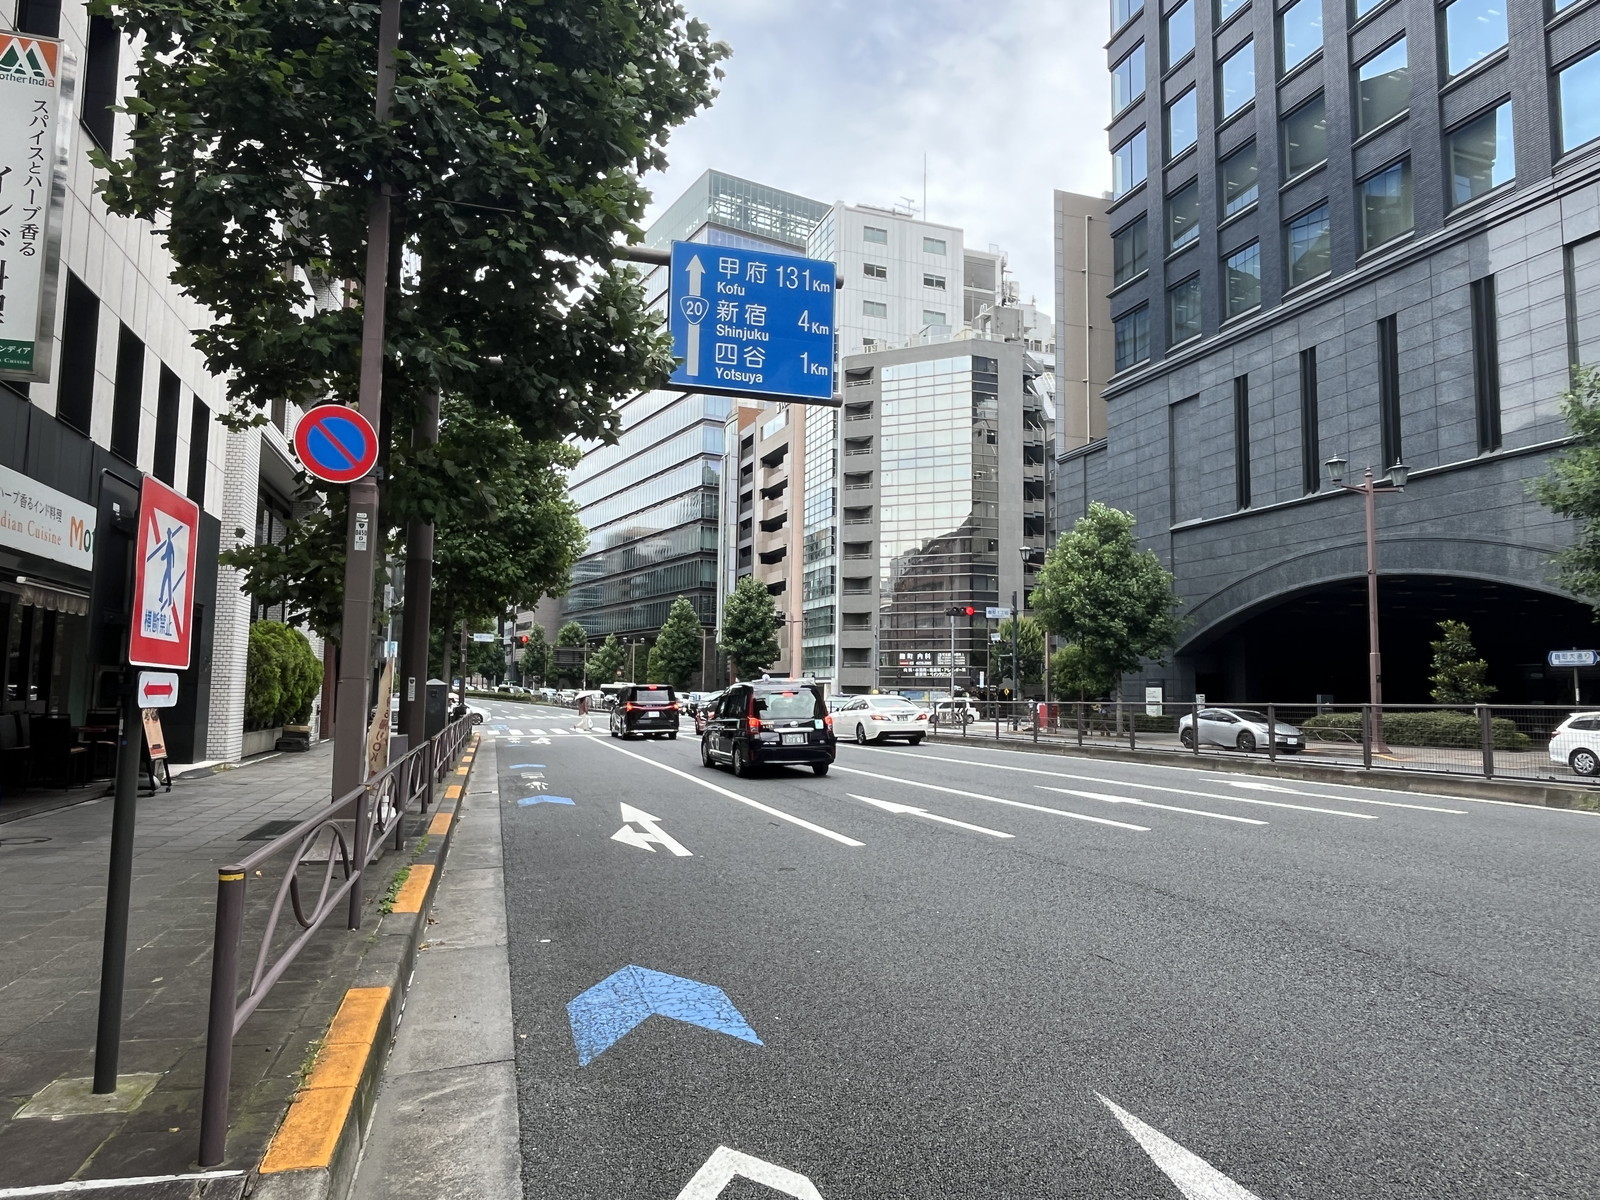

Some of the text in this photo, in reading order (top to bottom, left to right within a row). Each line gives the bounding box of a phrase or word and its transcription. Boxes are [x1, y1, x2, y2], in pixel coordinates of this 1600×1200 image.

[28, 76, 55, 88] India
[19, 99, 49, 257] スパイスとハーブ香る
[718, 256, 768, 284] 甲府
[717, 281, 746, 297] Kofu
[686, 301, 703, 316] 20
[716, 299, 767, 327] 新宿
[716, 324, 769, 342] Shinjuku
[715, 342, 766, 368] 四谷
[715, 367, 764, 385] Yotsuya
[27, 519, 62, 546] Cuisine
